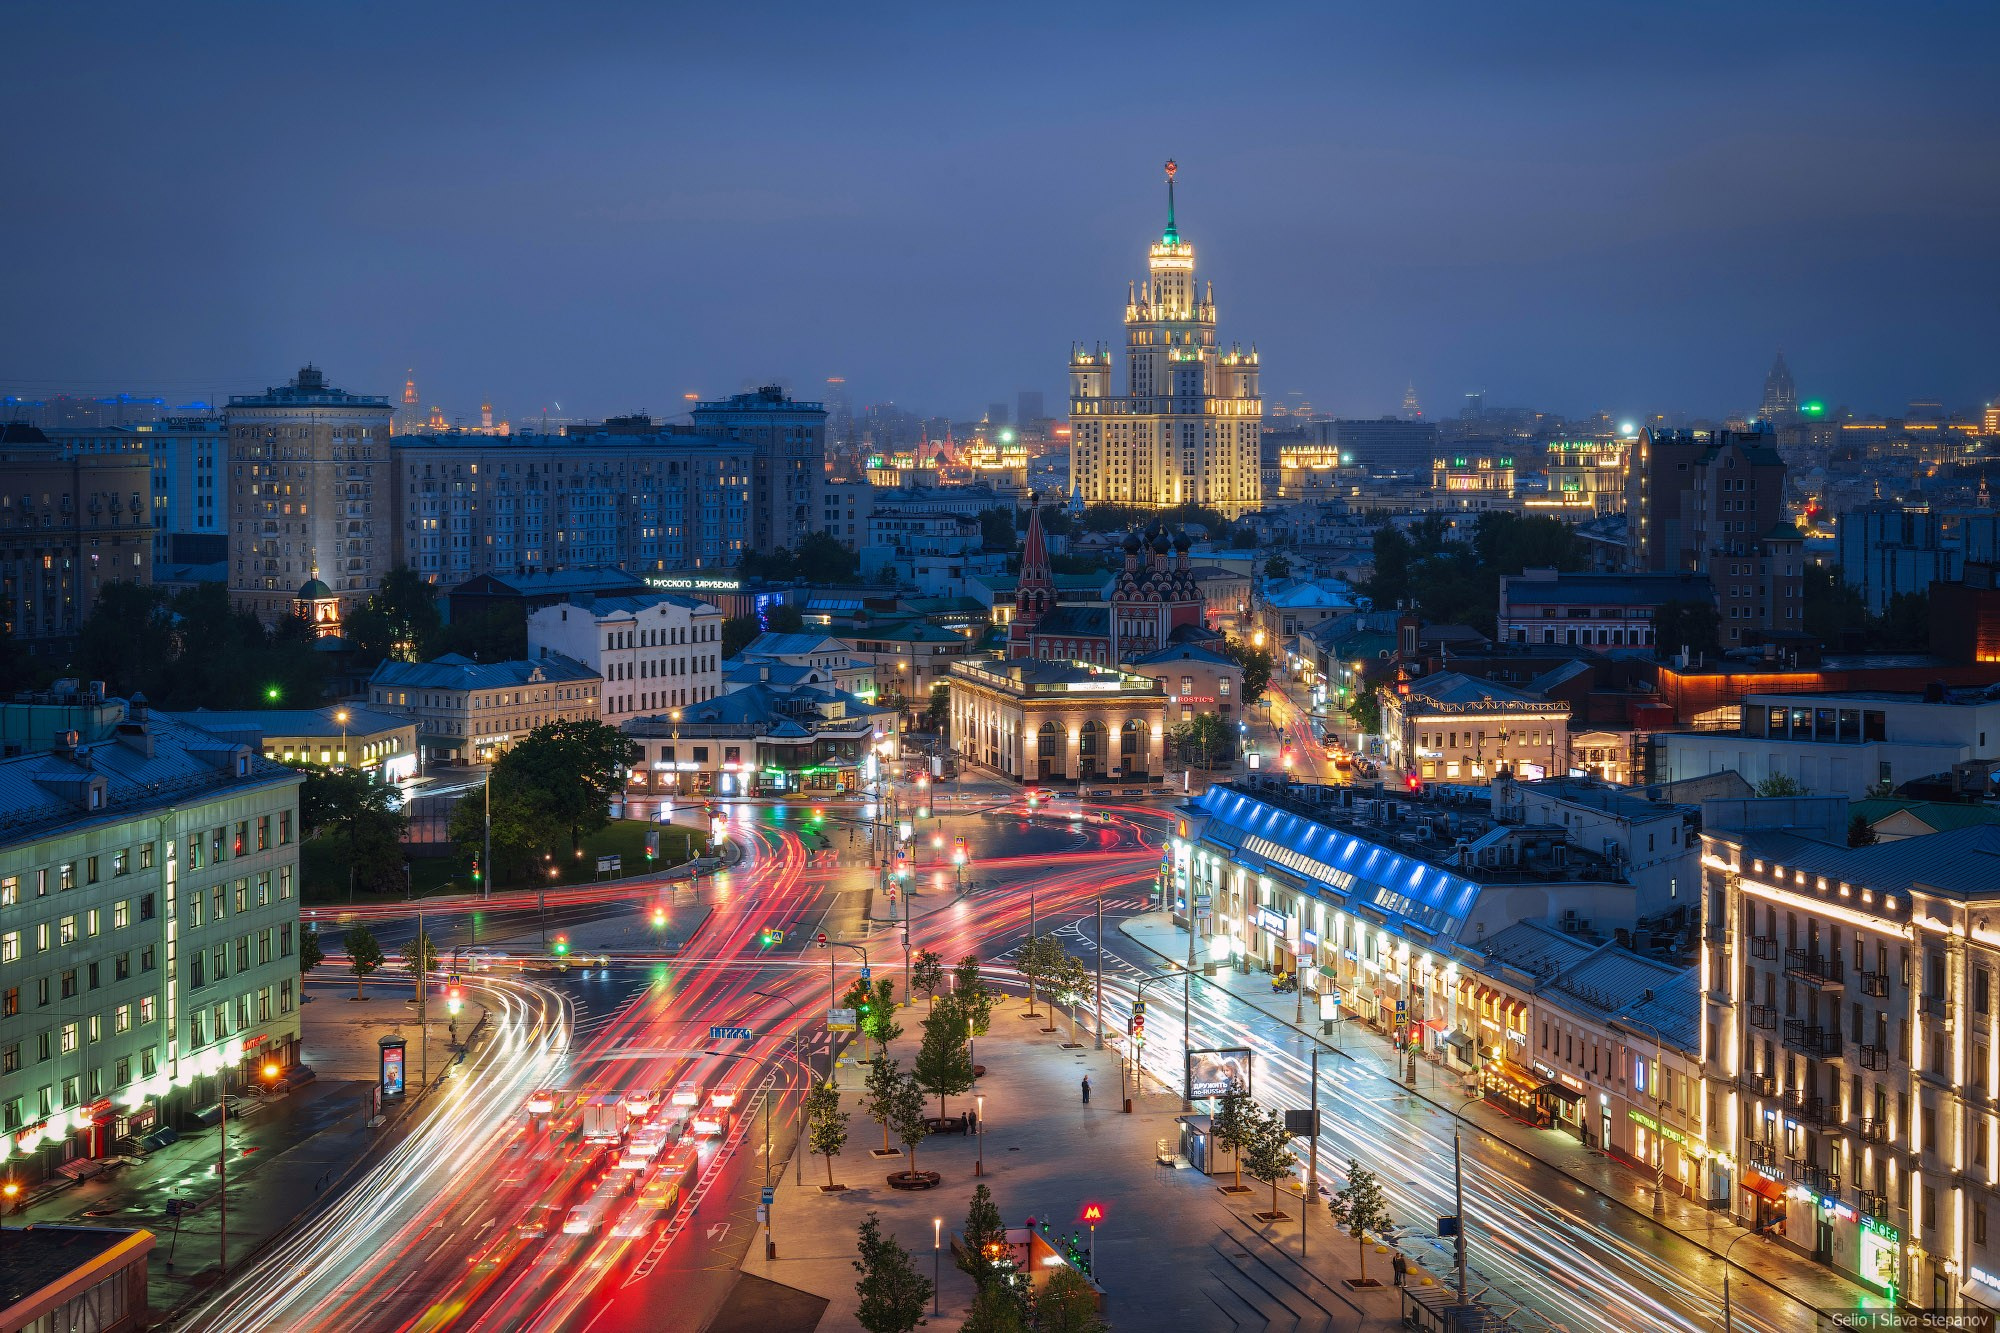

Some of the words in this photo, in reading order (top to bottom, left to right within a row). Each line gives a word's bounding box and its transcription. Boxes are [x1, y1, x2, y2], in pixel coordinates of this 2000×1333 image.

[653, 579, 692, 588] РУССКОГО
[695, 580, 739, 589] ЗАРУБЕЖЬЯ
[1193, 1082, 1228, 1090] ДРУЖИТЬ
